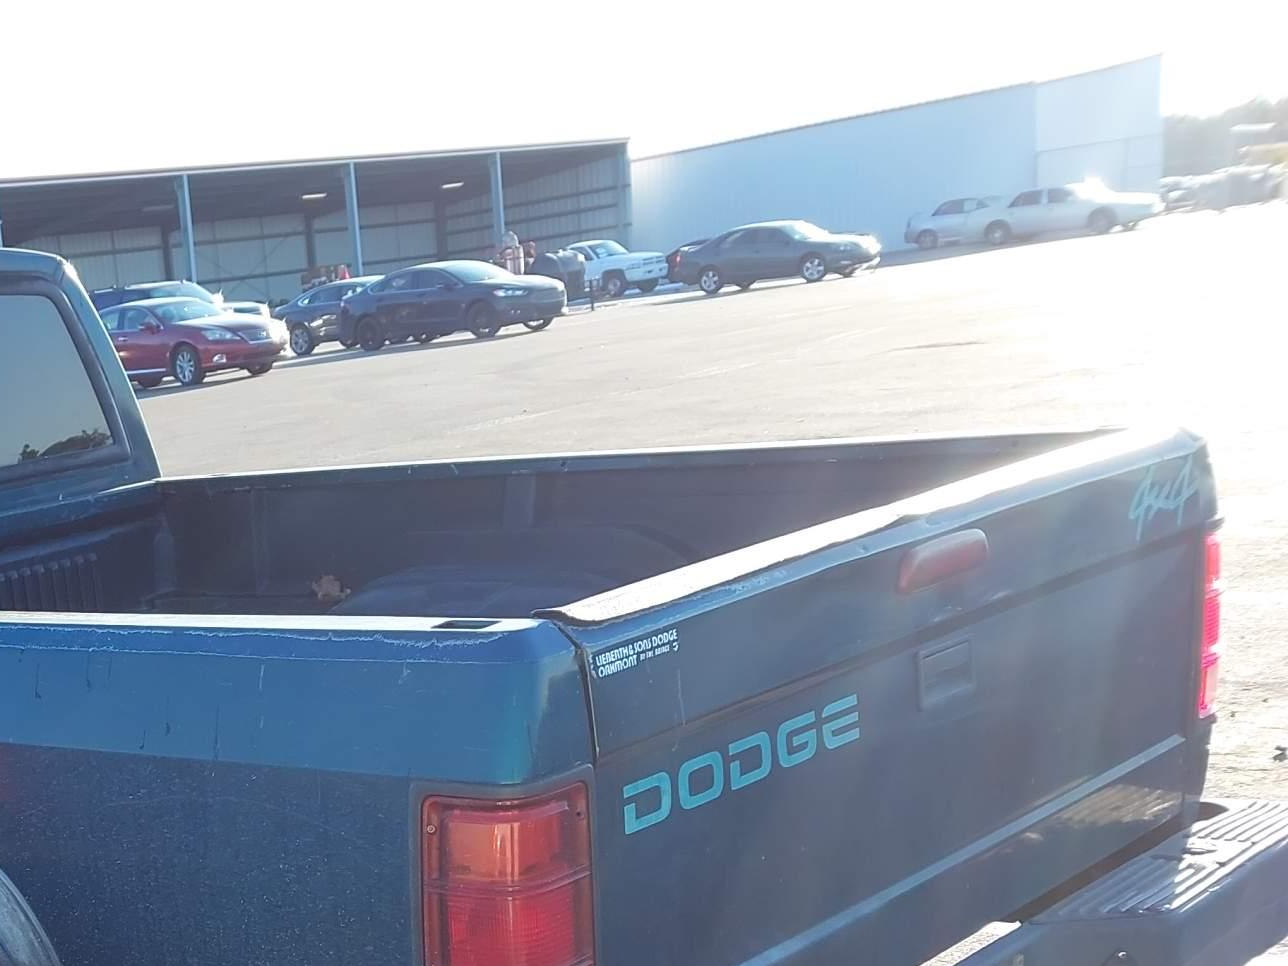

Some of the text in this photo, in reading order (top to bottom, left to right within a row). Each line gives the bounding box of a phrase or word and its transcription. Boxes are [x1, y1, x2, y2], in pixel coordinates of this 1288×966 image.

[633, 638, 652, 654] SONS
[651, 628, 678, 647] DODGE
[623, 694, 860, 835] DODGE
